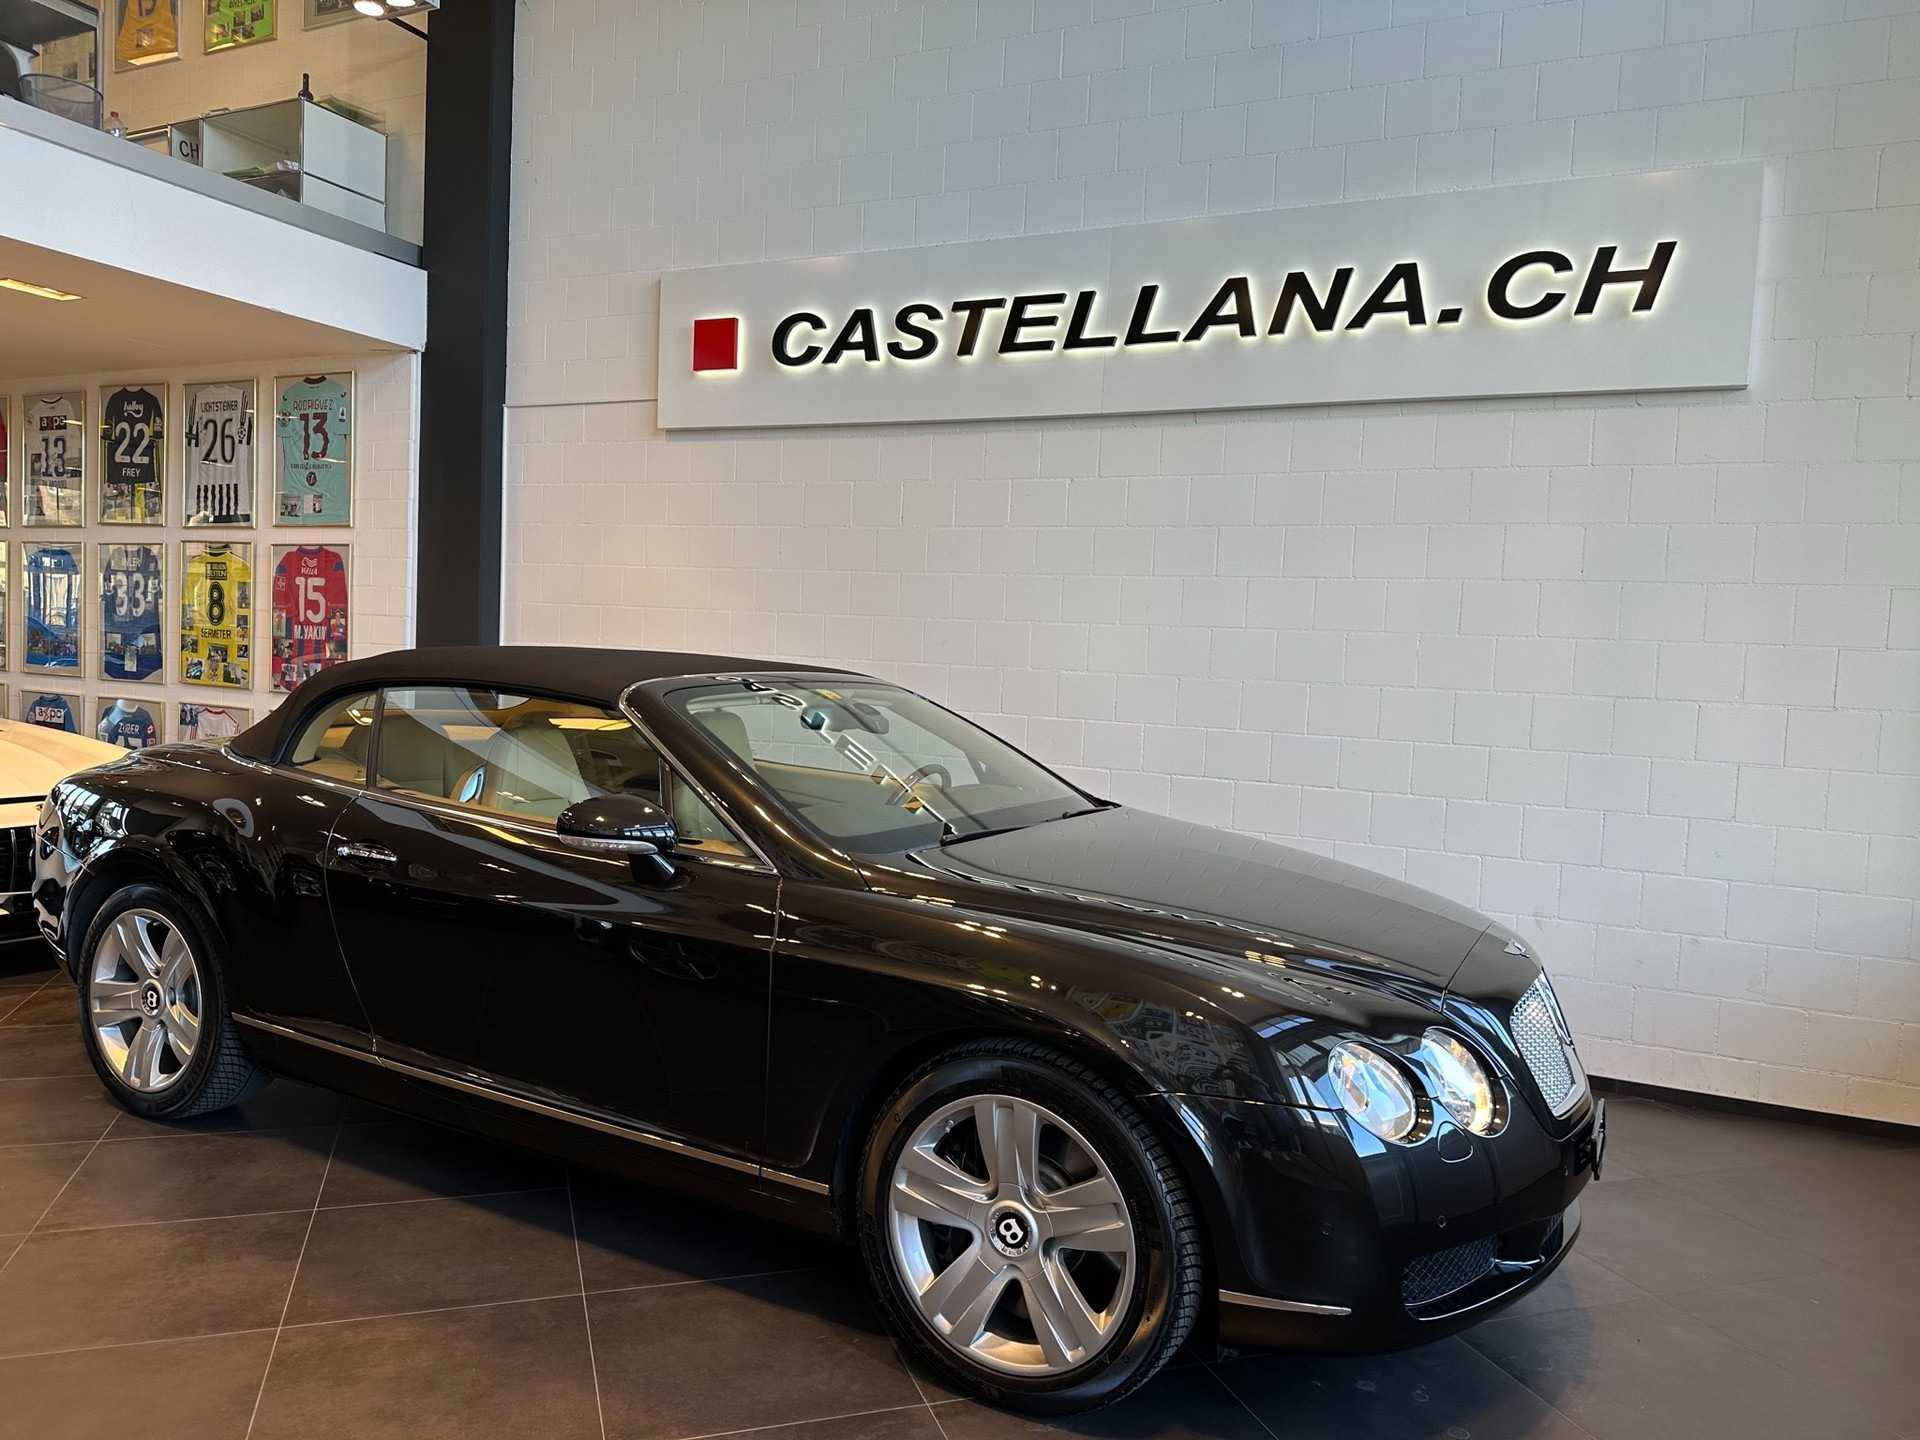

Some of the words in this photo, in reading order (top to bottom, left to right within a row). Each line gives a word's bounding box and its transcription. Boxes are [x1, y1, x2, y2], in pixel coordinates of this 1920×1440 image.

[771, 240, 1678, 367] CASTELLANA.CH
[200, 400, 238, 412] LICHTSTEINER
[293, 399, 333, 411] RODRIGUEZ
[41, 436, 67, 477] 13
[115, 421, 150, 464] 22
[202, 418, 235, 464] 26
[300, 412, 330, 460] 13
[122, 467, 141, 477] FREY
[115, 571, 146, 617] 33
[207, 581, 225, 626] 8
[295, 576, 326, 623] 15
